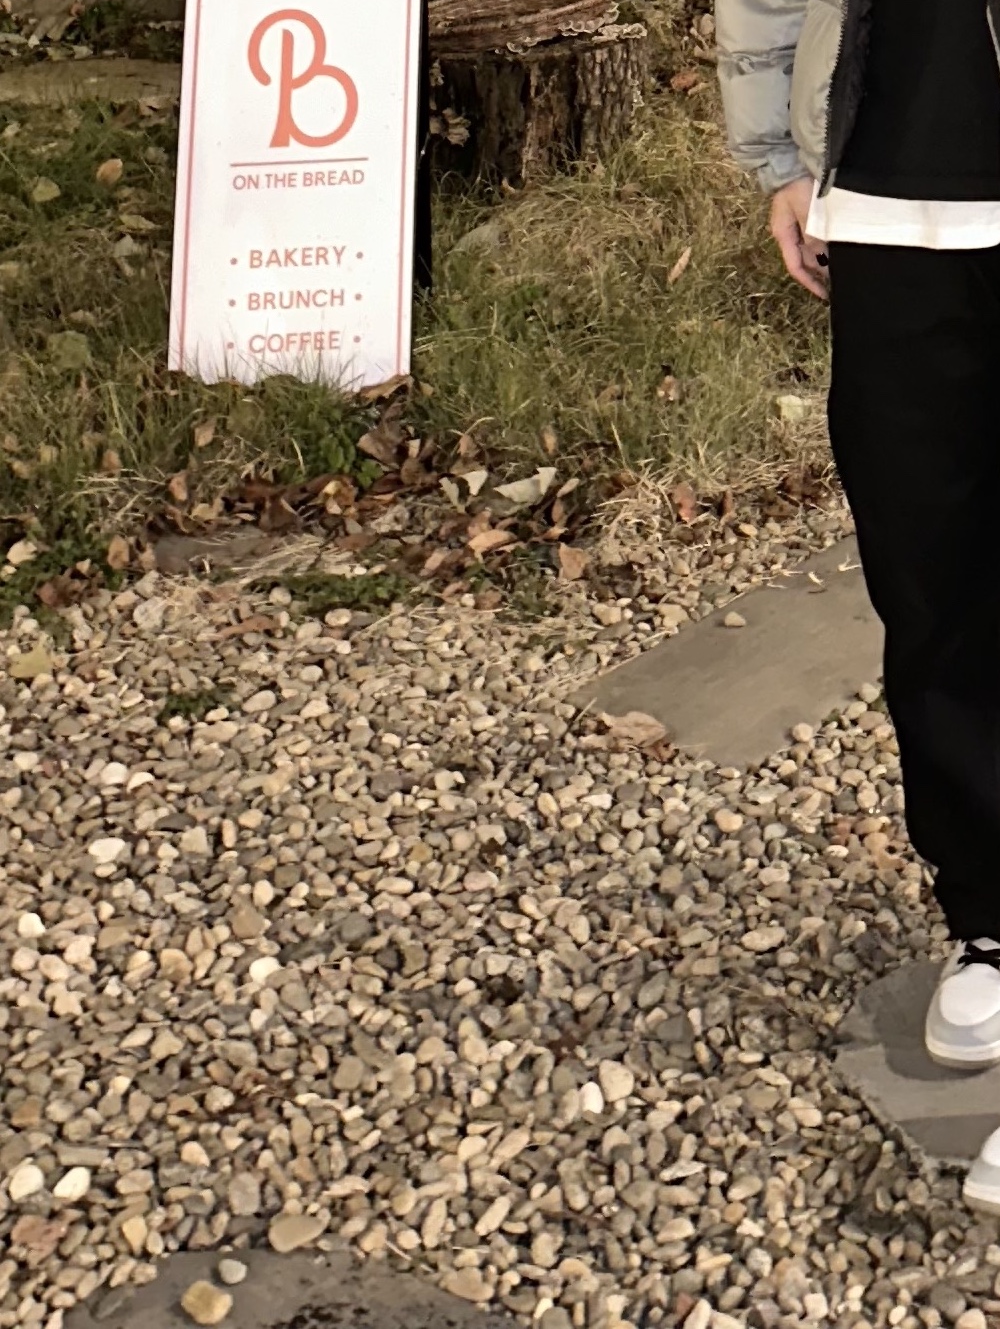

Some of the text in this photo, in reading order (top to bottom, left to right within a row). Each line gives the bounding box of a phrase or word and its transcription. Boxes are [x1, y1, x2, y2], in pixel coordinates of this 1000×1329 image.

[232, 169, 365, 191] ON THE BREAD
[249, 245, 346, 269] BAKERY
[247, 288, 345, 311] BRUNCH
[248, 330, 341, 353] COFFEE
